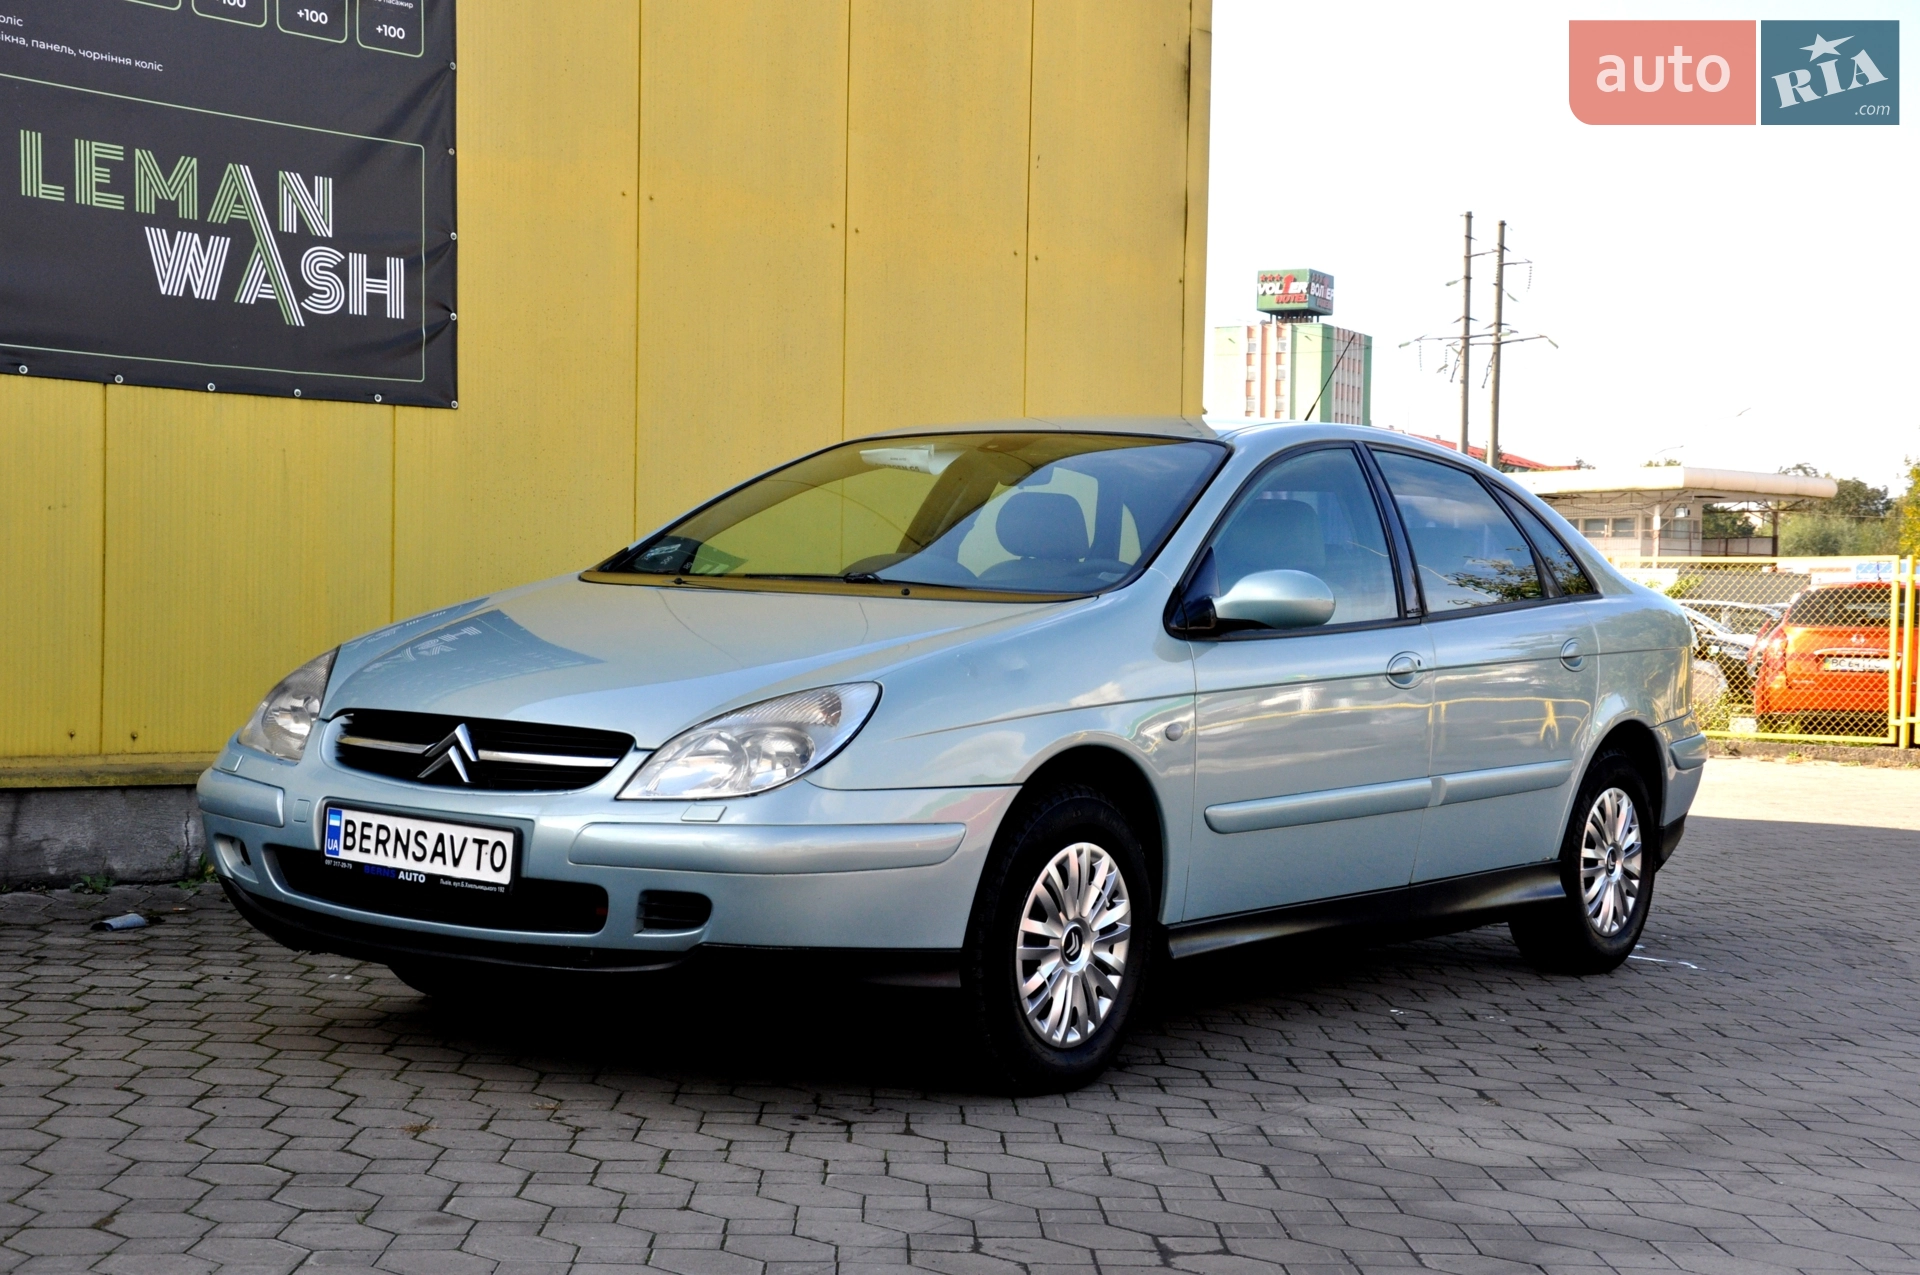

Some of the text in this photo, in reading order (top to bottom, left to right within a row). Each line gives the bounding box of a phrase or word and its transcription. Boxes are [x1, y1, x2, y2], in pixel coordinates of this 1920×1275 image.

[296, 8, 329, 25] +100
[375, 24, 406, 40] +100
[0, 31, 164, 72] ікна, панель, чорніння коліс
[20, 129, 333, 238] LEMAN
[145, 226, 405, 327] WASH
[1275, 293, 1309, 304] HOTEL
[327, 819, 507, 873] UA BERNSAVTO
[363, 864, 426, 884] BERNS AUTO
